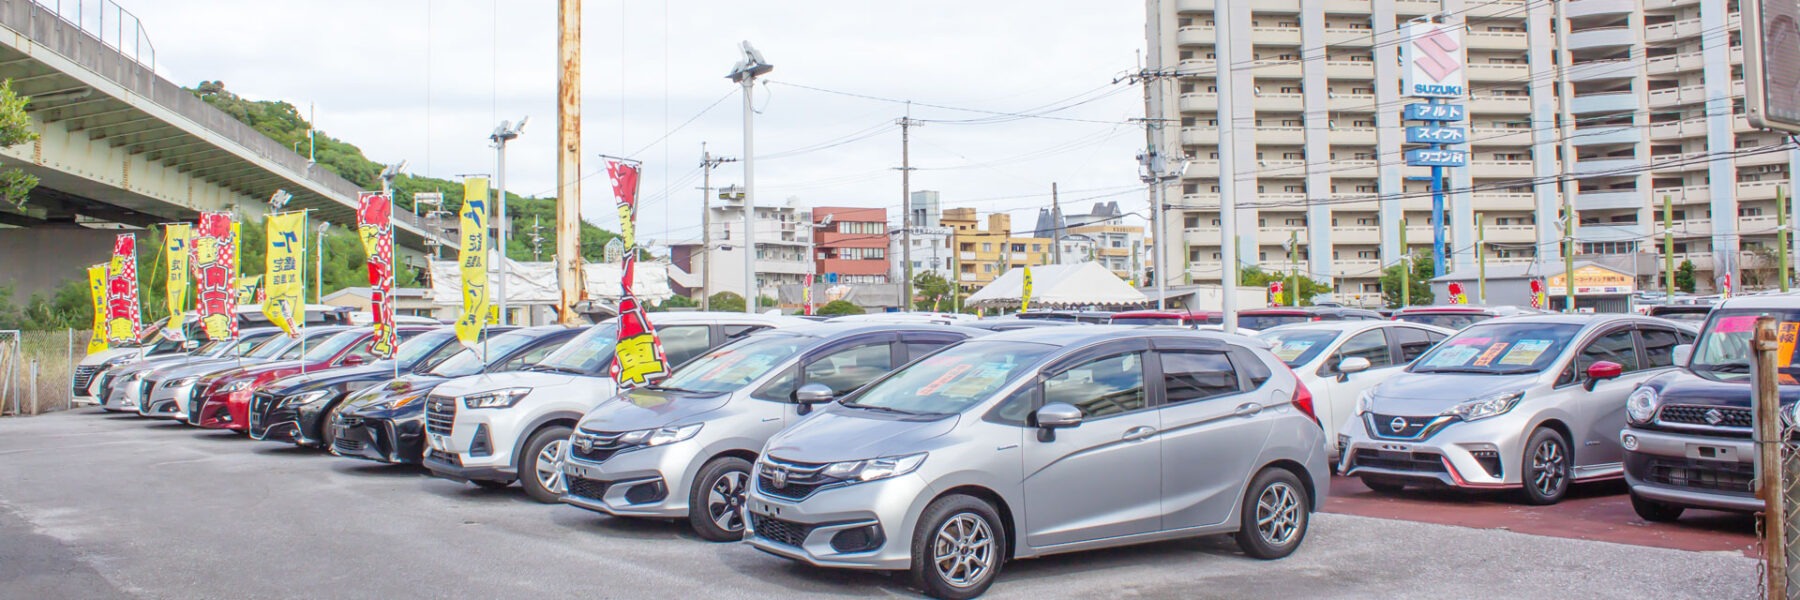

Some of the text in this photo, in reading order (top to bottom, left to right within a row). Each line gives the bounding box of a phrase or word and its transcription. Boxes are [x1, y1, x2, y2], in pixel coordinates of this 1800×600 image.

[1415, 84, 1462, 95] SUZUKI
[1419, 106, 1460, 118] アルト
[1418, 128, 1462, 140] スイフト
[1419, 151, 1464, 163] ワゴンR
